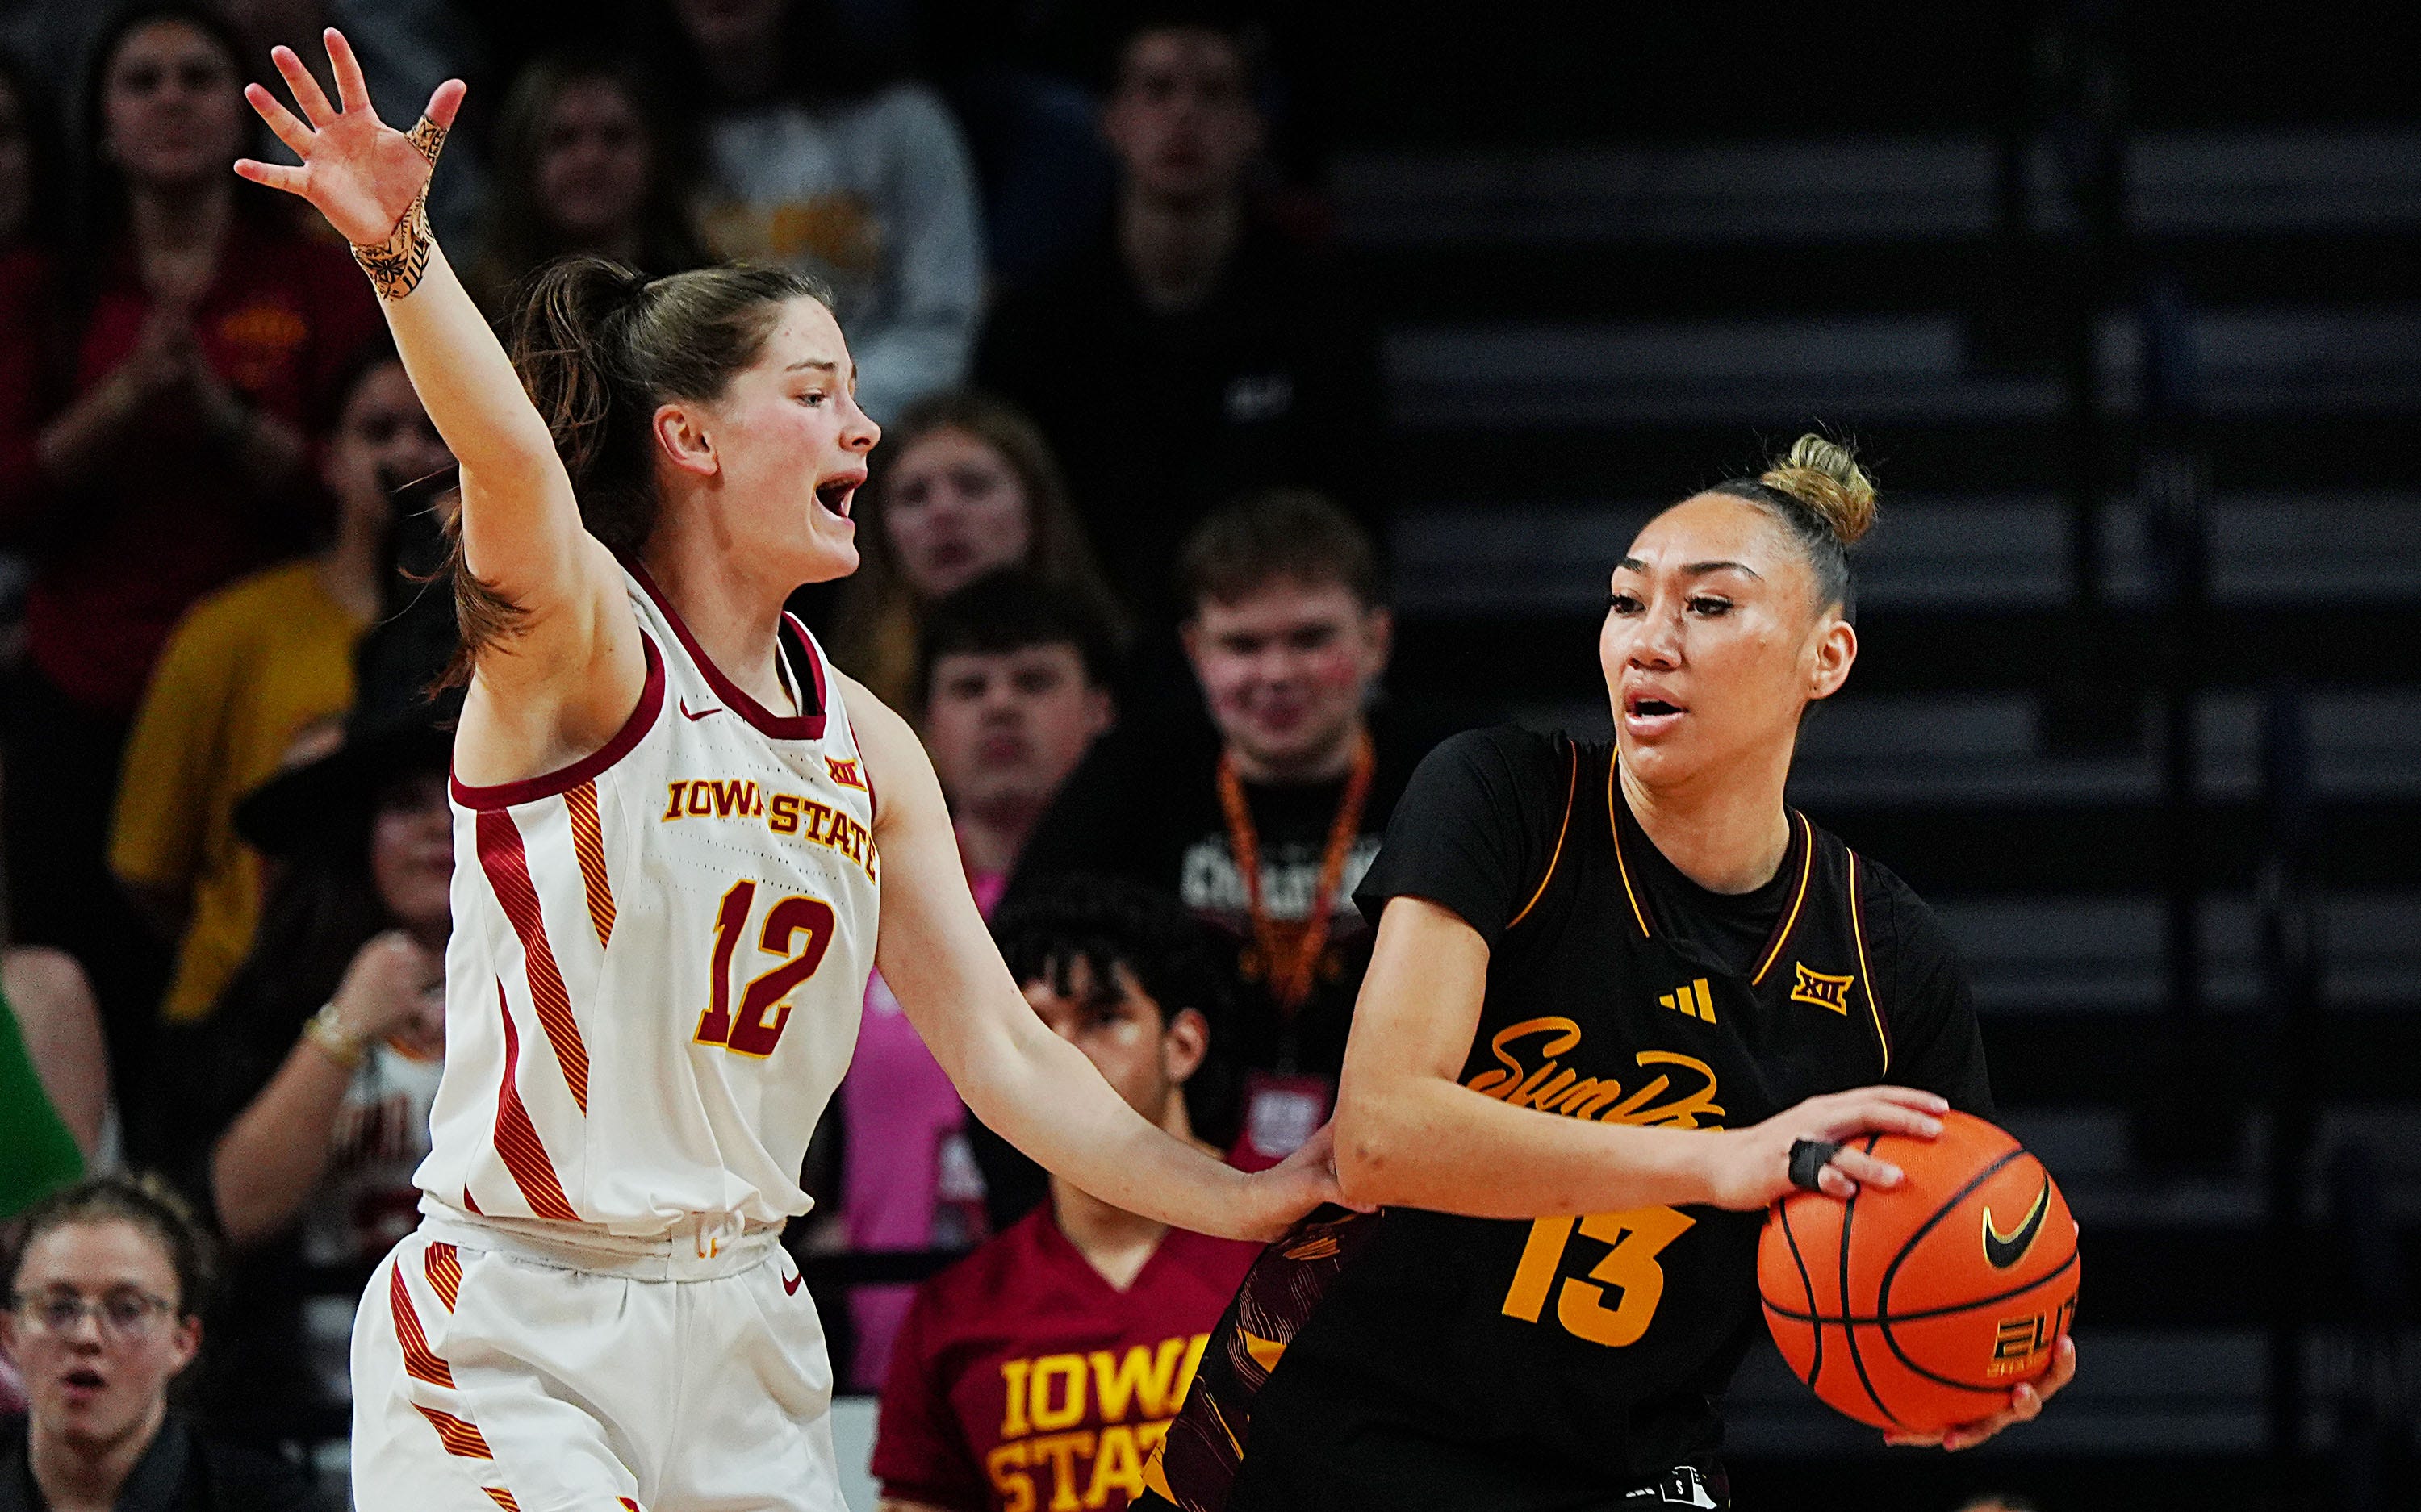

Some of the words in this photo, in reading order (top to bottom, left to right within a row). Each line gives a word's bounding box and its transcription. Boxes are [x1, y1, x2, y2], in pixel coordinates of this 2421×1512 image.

[769, 794, 876, 886] STATE
[693, 879, 836, 1059] 12
[1501, 1205, 1697, 1348] 13
